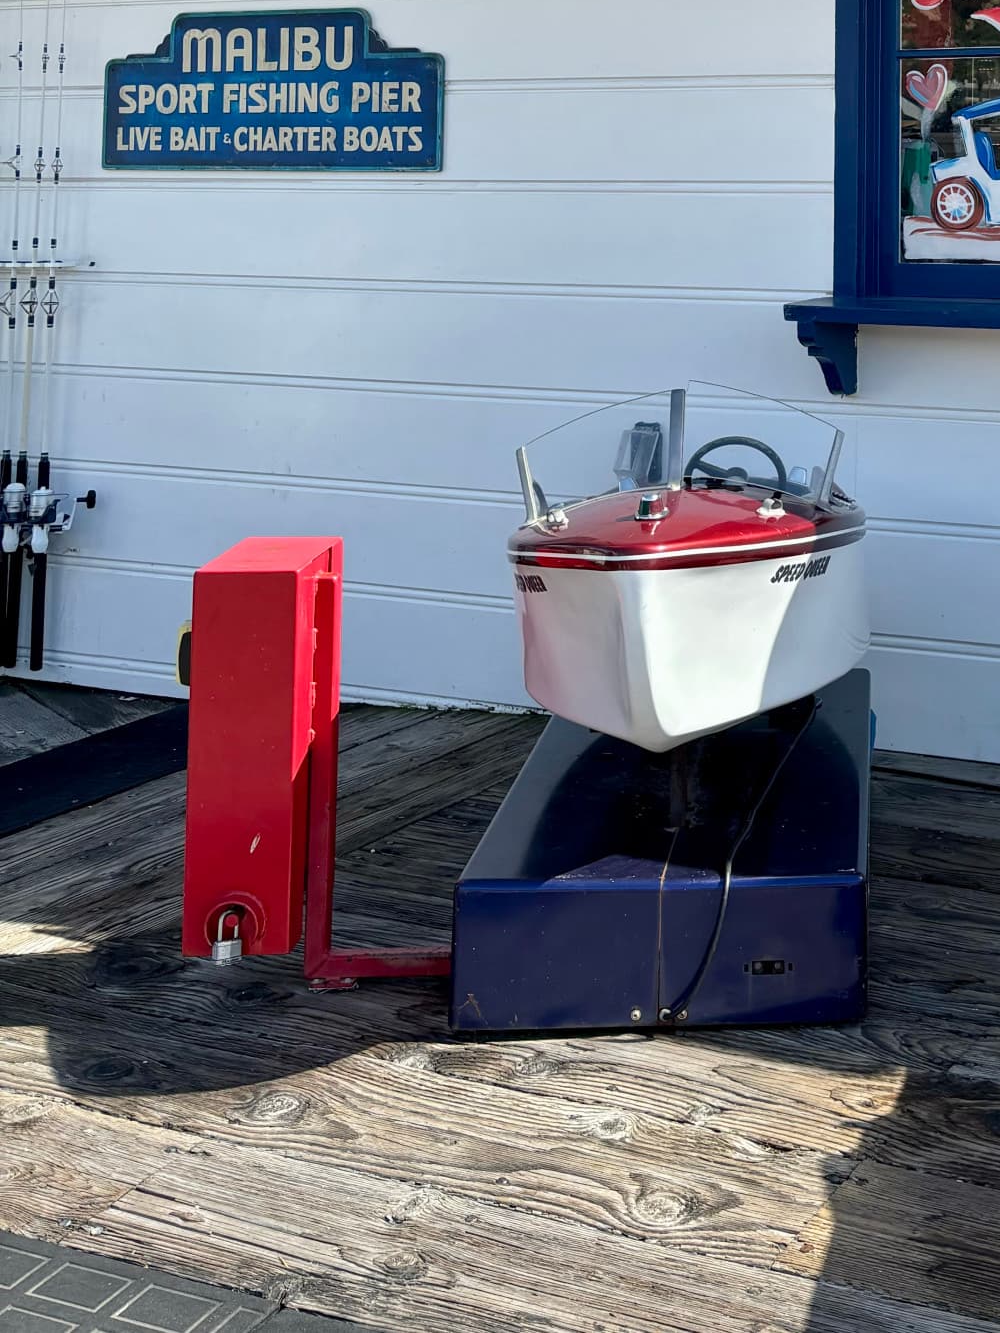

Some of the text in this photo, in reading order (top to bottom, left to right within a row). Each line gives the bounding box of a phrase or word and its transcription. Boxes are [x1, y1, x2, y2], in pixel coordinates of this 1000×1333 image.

[182, 26, 354, 73] MALIBU
[118, 80, 422, 114] SPORT FISHING PIER
[116, 125, 423, 153] LIVE BAIT & CHARTER BOATS
[771, 562, 806, 584] SPEED
